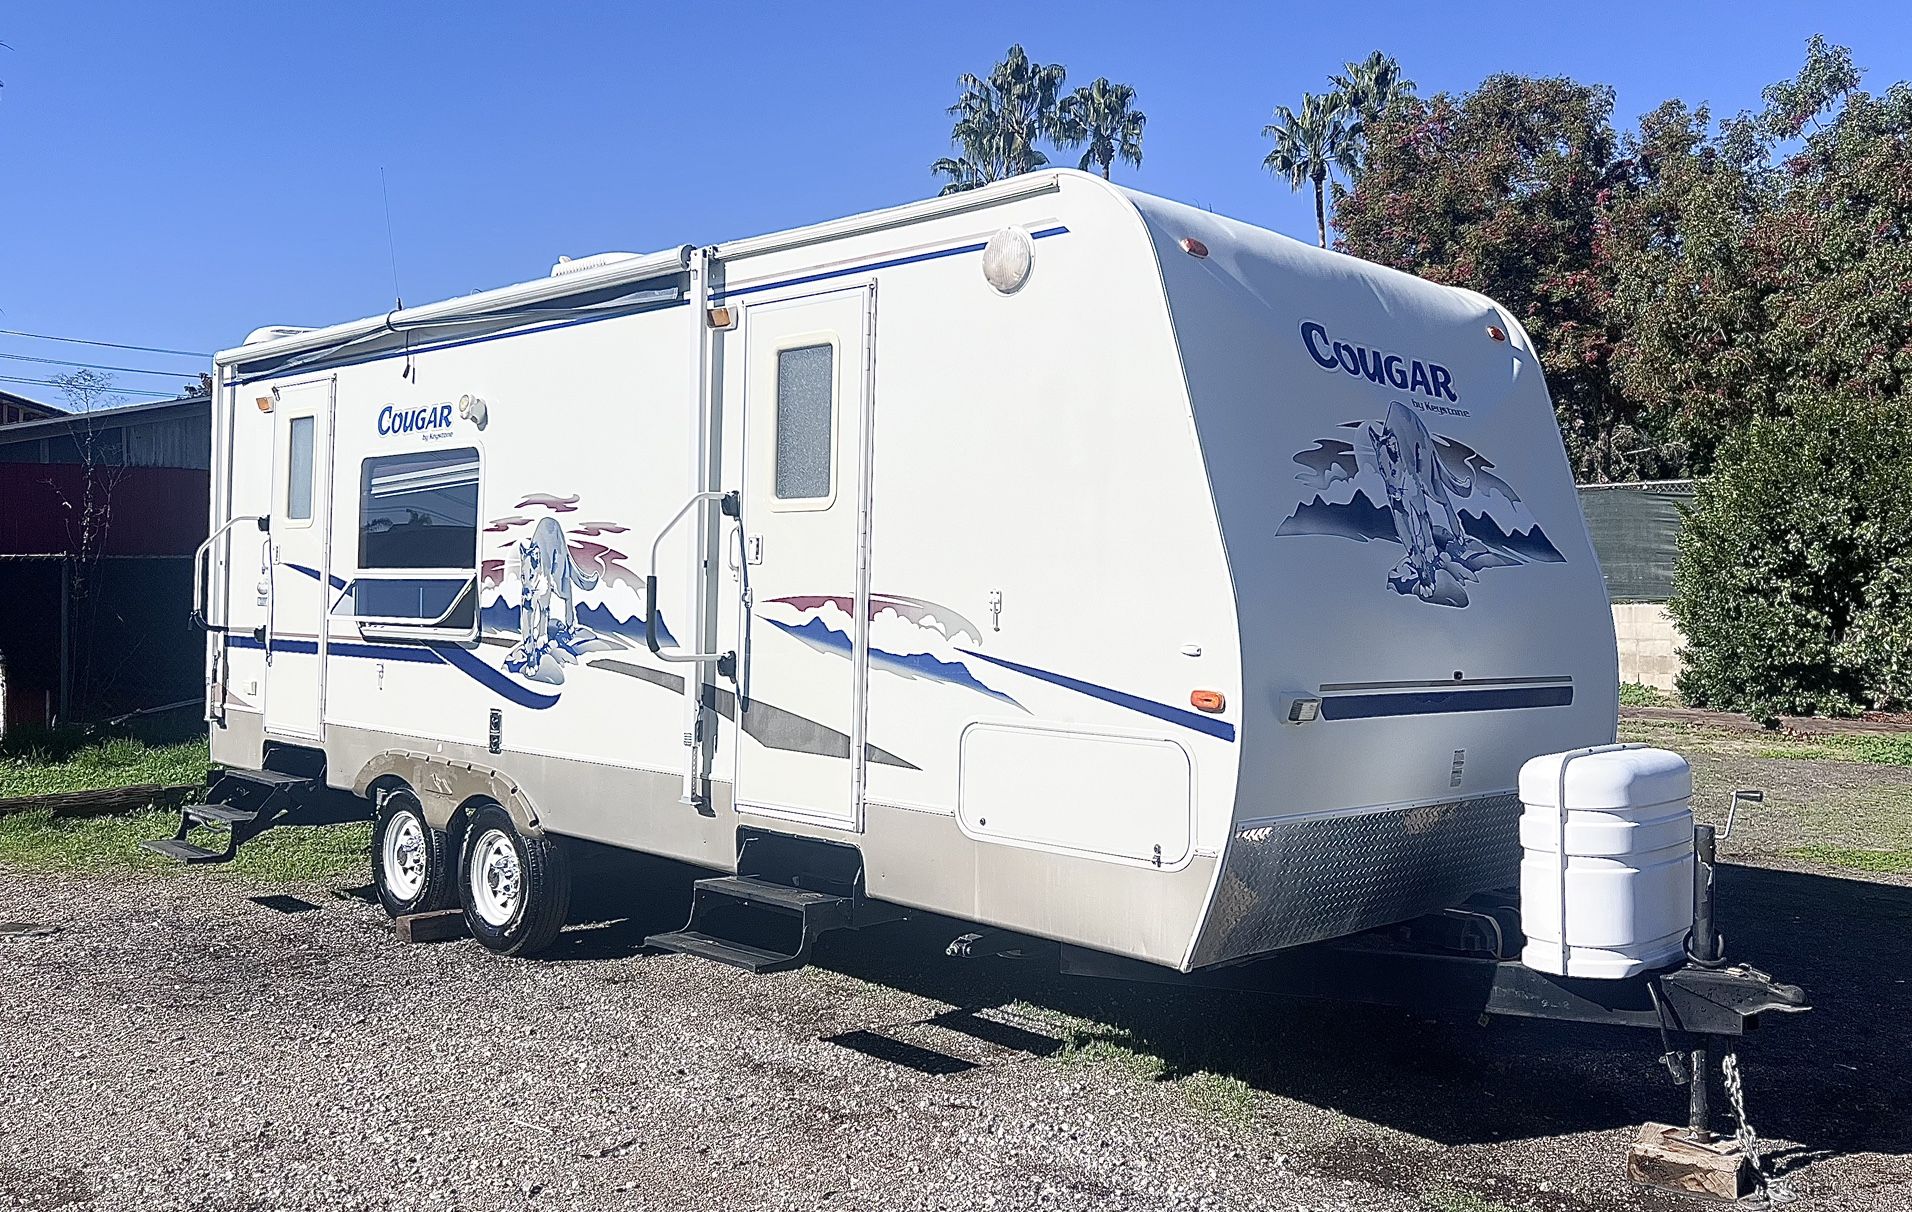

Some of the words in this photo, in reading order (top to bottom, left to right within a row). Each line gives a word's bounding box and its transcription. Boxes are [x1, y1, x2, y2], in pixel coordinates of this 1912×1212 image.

[1300, 321, 1458, 403] COUGAR
[378, 405, 452, 435] COUGAR
[1411, 399, 1425, 411] by
[1425, 402, 1471, 418] Keystone
